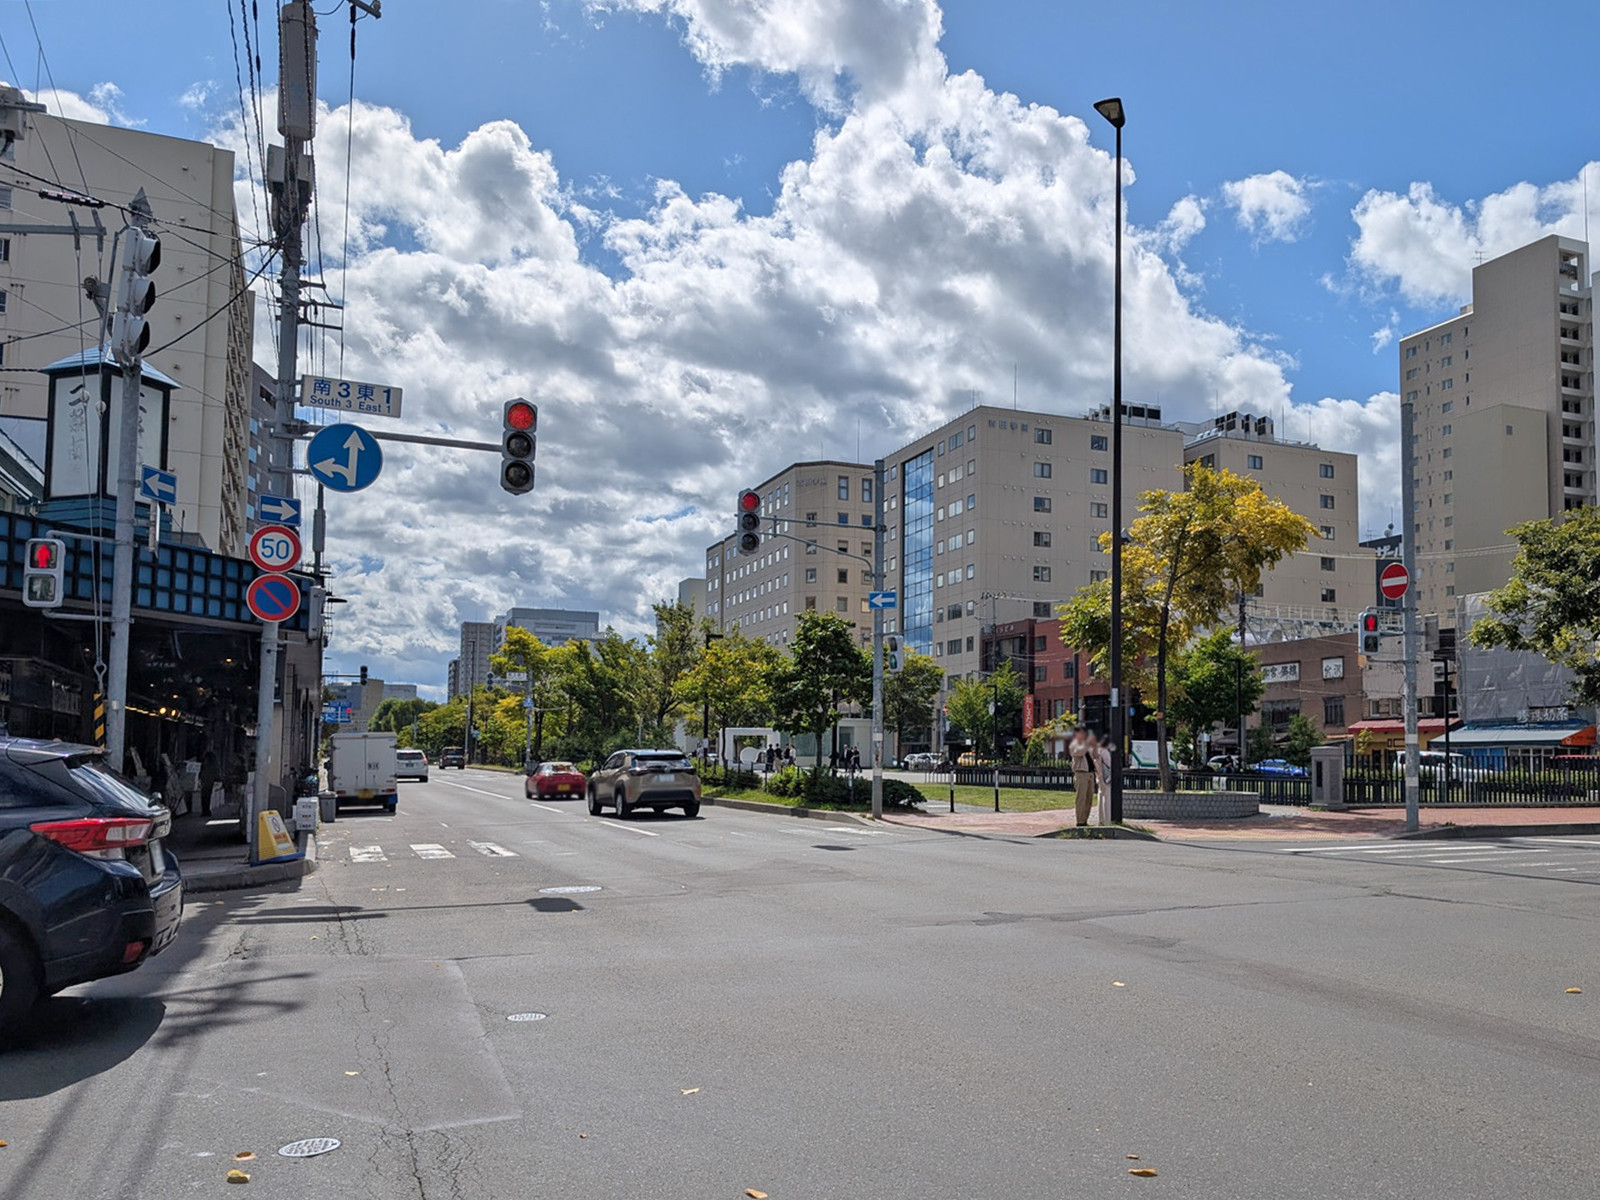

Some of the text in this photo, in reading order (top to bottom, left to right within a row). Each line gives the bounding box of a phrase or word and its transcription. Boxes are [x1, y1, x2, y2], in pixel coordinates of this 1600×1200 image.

[310, 395, 392, 413] South 3 East 1
[261, 538, 290, 560] 50
